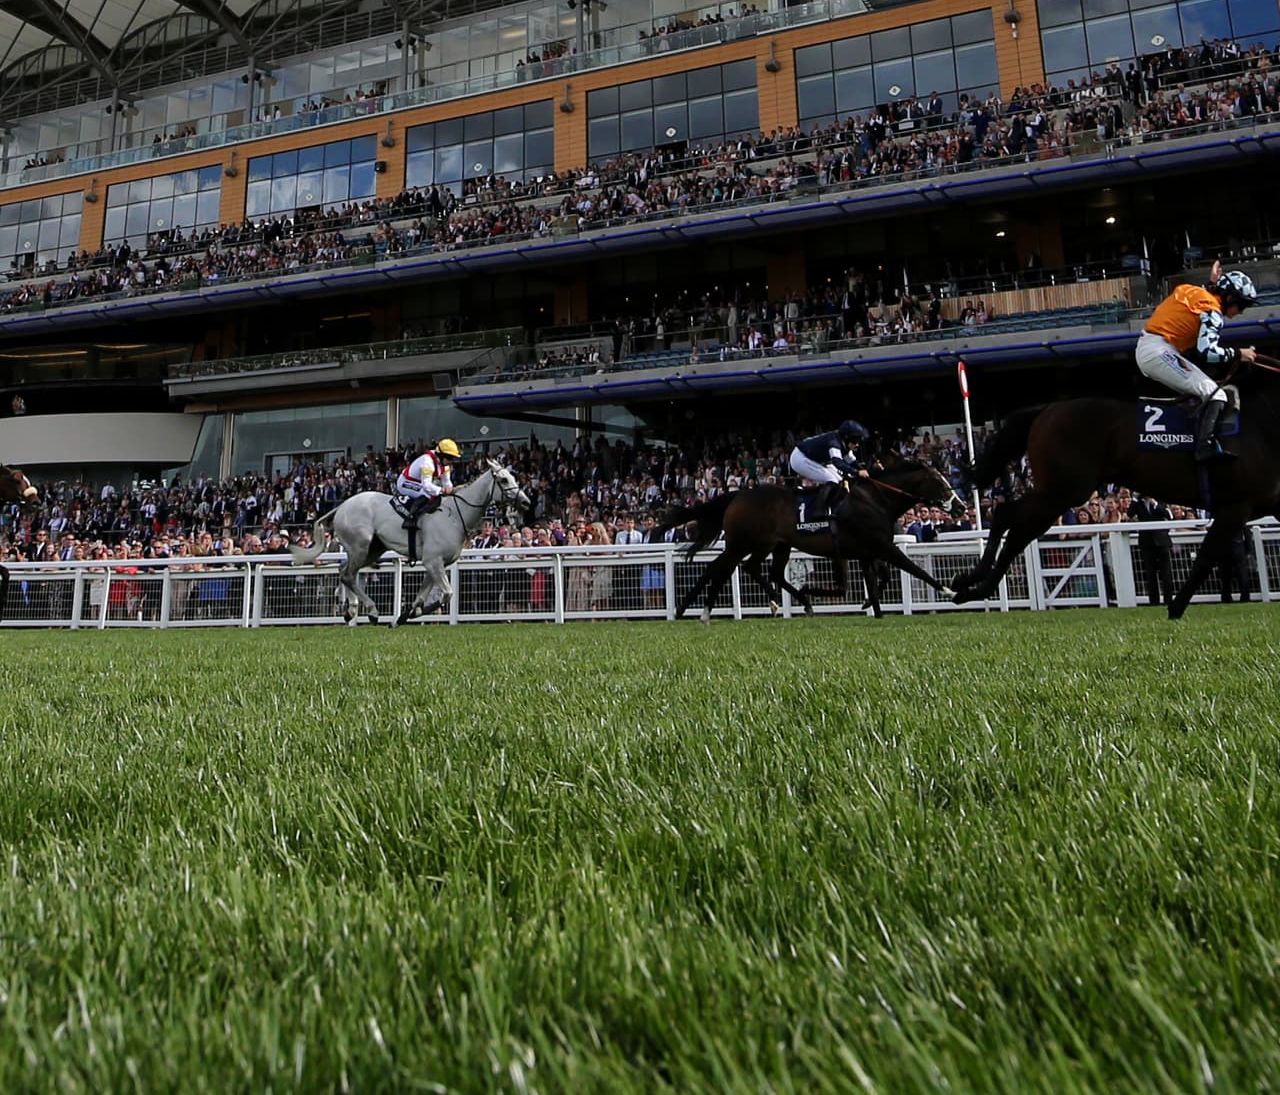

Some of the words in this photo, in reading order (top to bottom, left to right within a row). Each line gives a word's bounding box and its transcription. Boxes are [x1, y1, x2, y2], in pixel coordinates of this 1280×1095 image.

[1144, 405, 1166, 432] 2
[1139, 434, 1194, 443] LONGINES
[798, 502, 806, 523] 1
